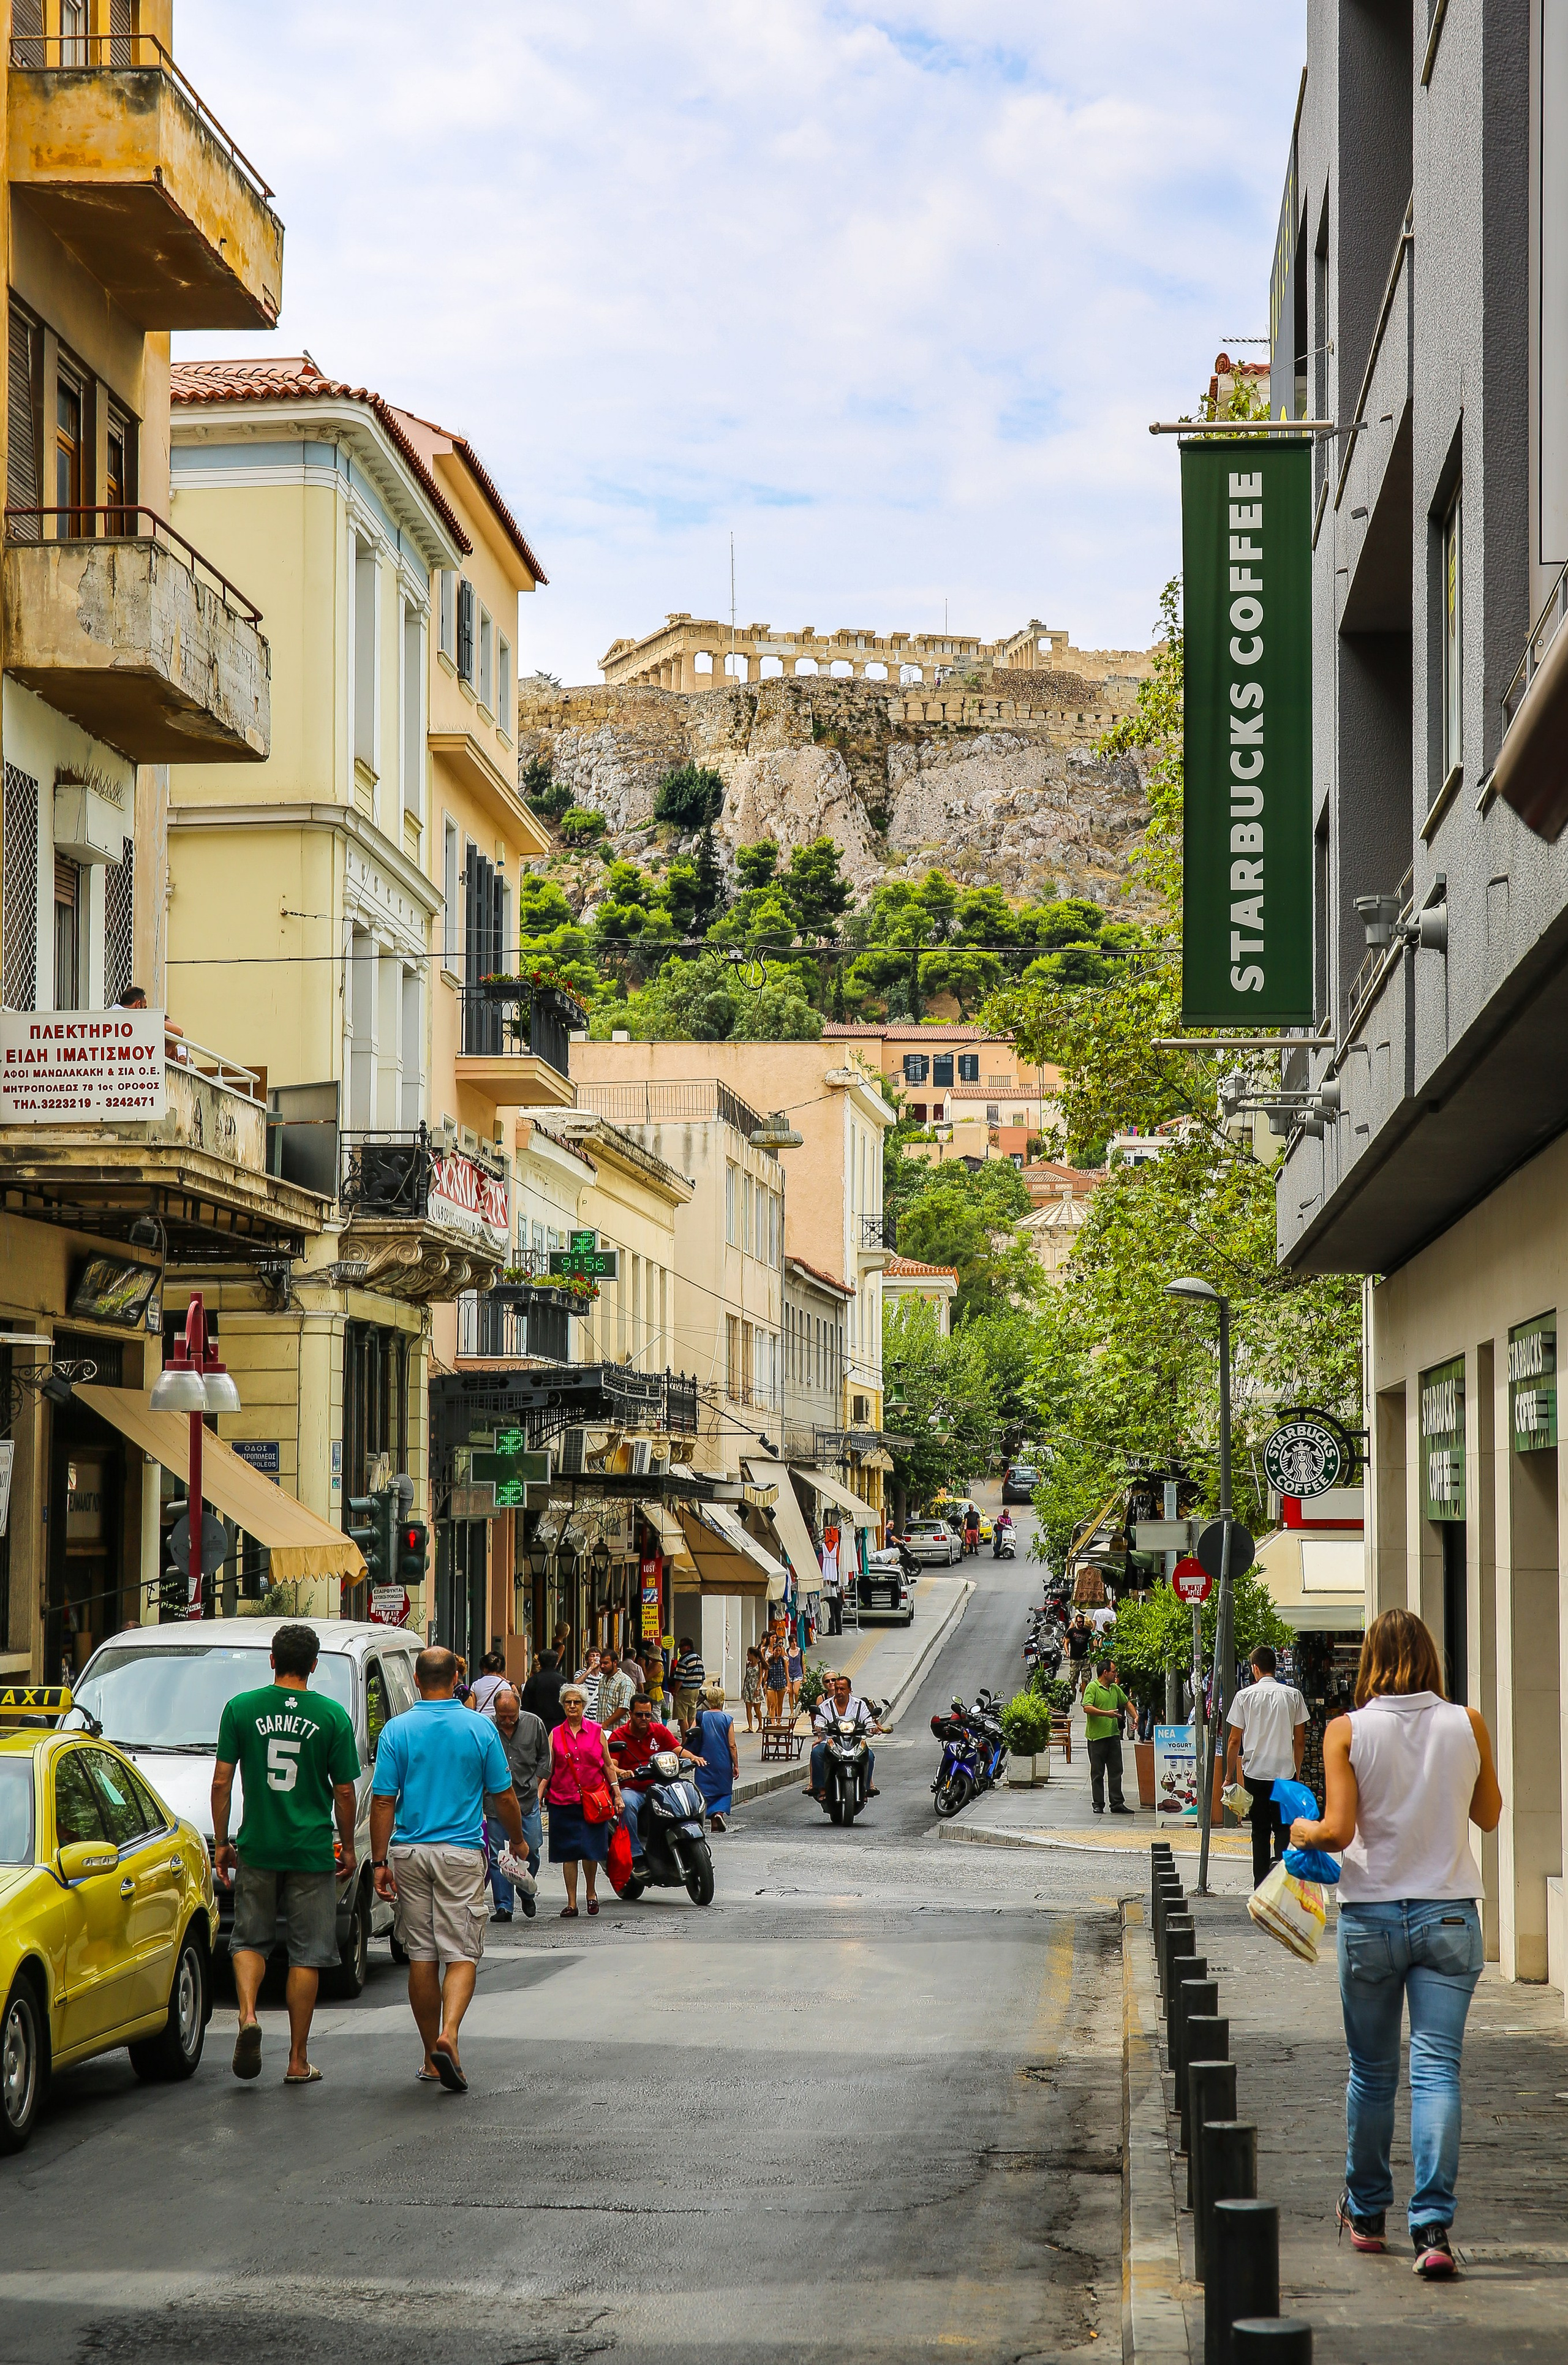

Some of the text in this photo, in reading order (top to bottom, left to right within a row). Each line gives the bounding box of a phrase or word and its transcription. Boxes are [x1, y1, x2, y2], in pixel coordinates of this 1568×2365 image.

[1229, 471, 1264, 994] STARBUCKS COFFEE
[30, 1023, 134, 1039] ΠΛΕΚΤΗΡΙΟ
[6, 1046, 156, 1063] ΕΙΔΗ ΙΜΑΤΙΣΜΟΥ
[3, 1066, 160, 1078] ΑΦΟΙ ΜΑΝΩΛΑΚΑΚΗ & ΣΙΑ Ο.Ε.
[2, 1084, 78, 1093] ΜΗΤΡΟΠΟΛΕΩΣ
[118, 1082, 160, 1090] ΟΡΟΦΟΣ
[105, 1096, 154, 1107] 3242471
[561, 1257, 606, 1272] 9:56
[1508, 1331, 1543, 1383] STARBUCKS
[1422, 1378, 1457, 1437] STARBUCKS
[1515, 1389, 1539, 1433] COFFEE
[1268, 1425, 1336, 1459] STARBUCKS
[1276, 1474, 1330, 1494] COFFEE
[1429, 1450, 1452, 1501] COFFEE
[1, 1689, 50, 1705] AXI
[255, 1714, 320, 1740] GARNETT
[267, 1738, 301, 1792] 5
